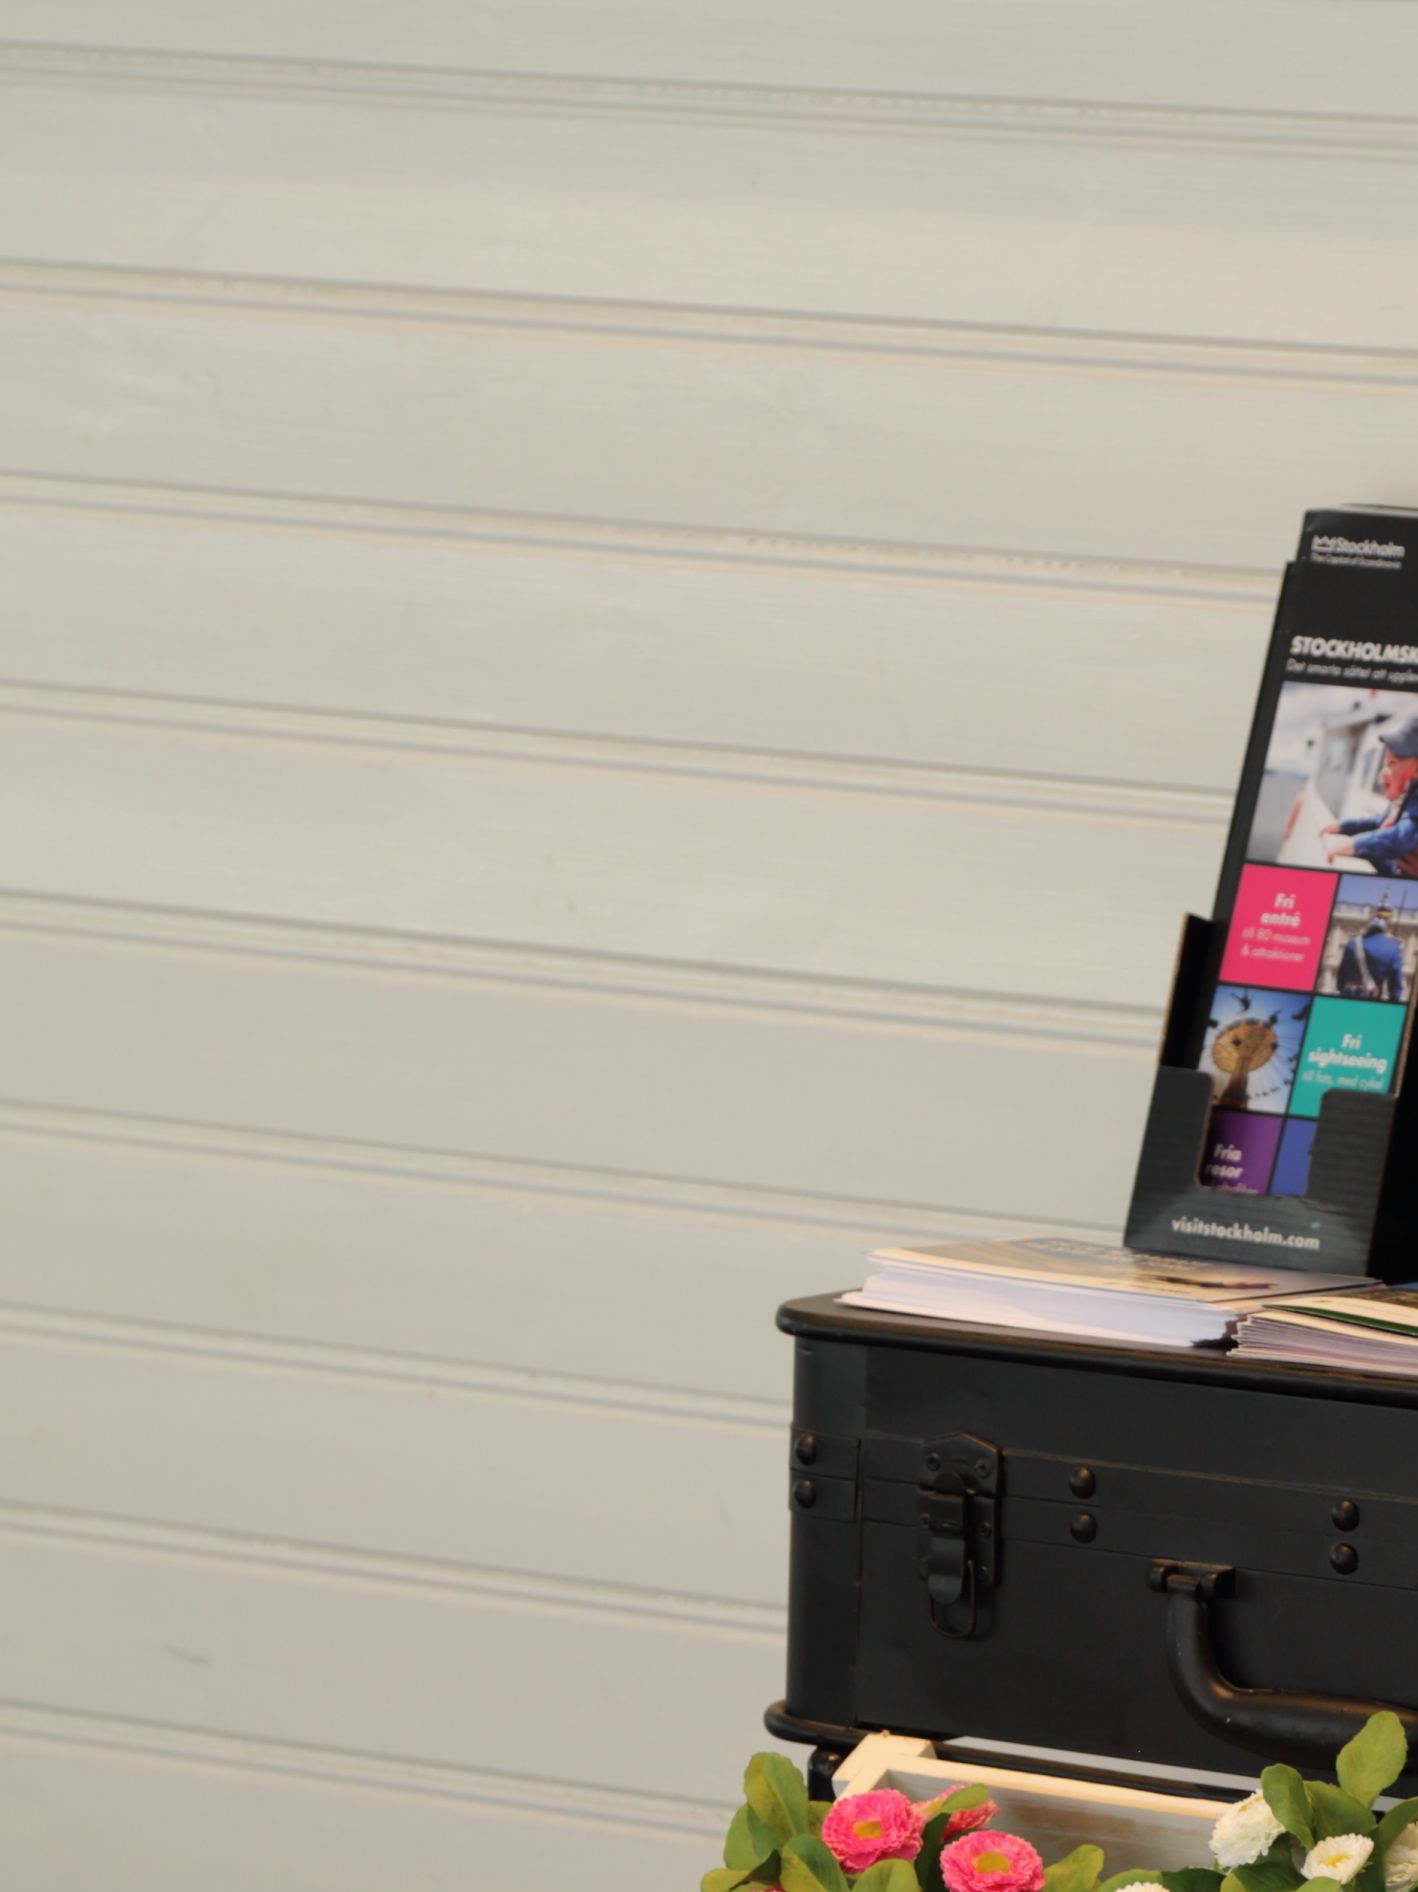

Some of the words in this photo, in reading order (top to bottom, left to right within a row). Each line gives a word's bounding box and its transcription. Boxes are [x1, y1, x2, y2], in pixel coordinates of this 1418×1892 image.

[1336, 537, 1405, 558] Stockholm
[1285, 658, 1305, 673] Det
[1306, 663, 1342, 676] smarta
[1372, 667, 1387, 681] att
[1274, 892, 1296, 910] Fri
[1260, 911, 1302, 928] entré
[1341, 1032, 1362, 1050] Fri
[1308, 1046, 1387, 1075] sightseeing
[1214, 1144, 1242, 1162] Fria
[1171, 1215, 1321, 1250] visitstockholm.com
